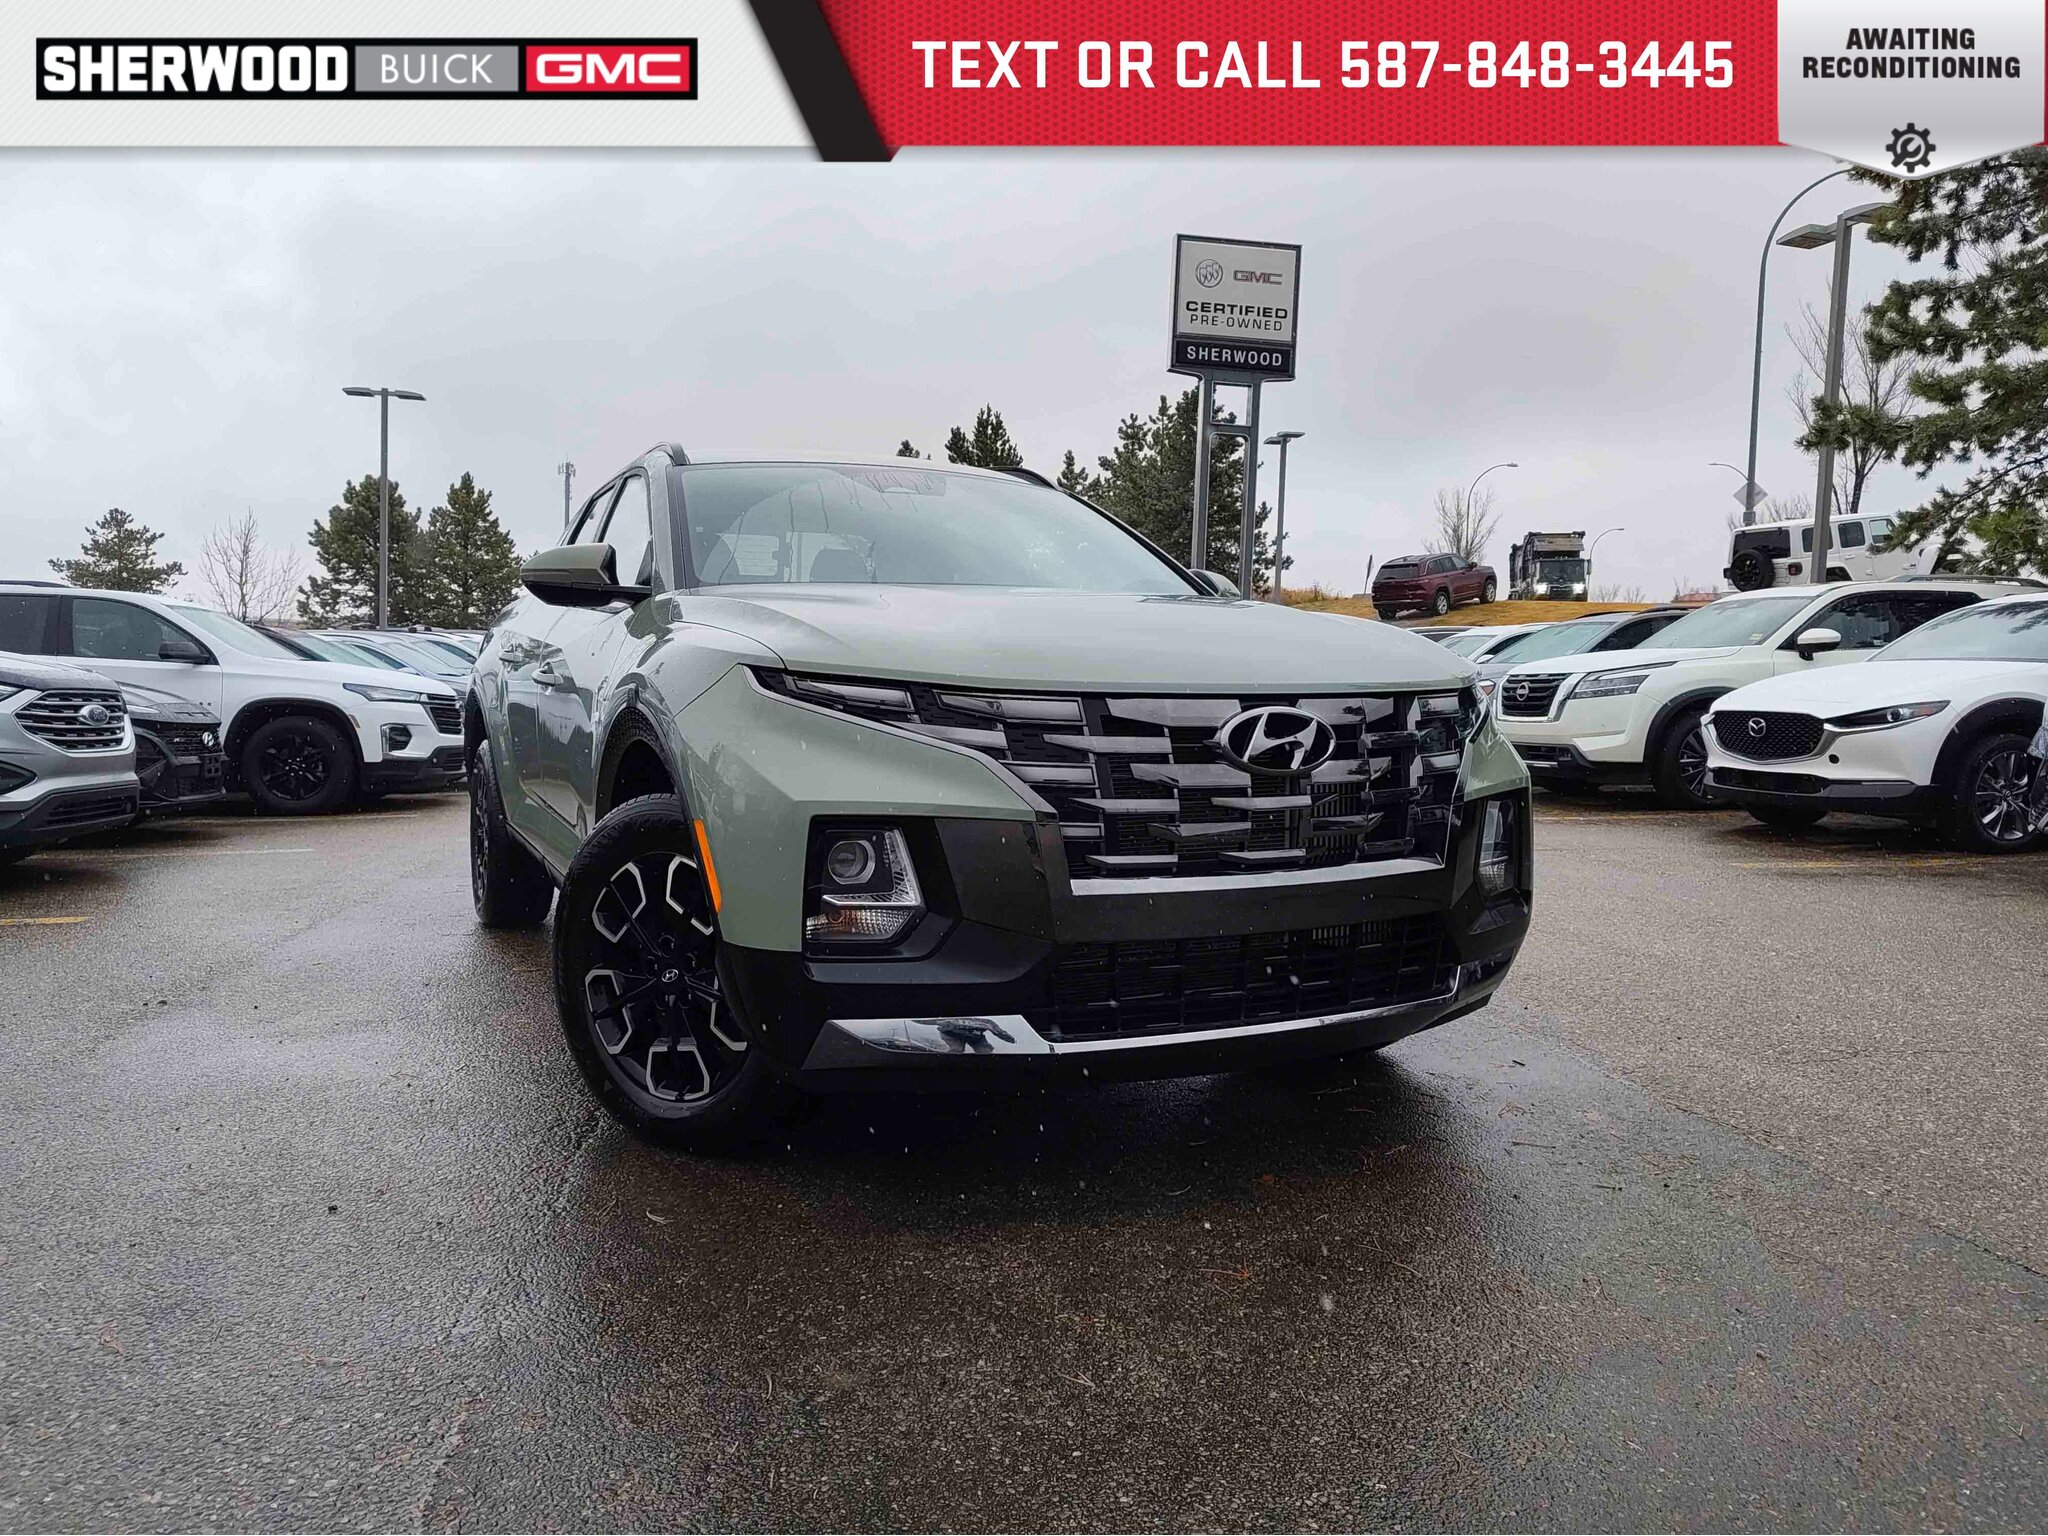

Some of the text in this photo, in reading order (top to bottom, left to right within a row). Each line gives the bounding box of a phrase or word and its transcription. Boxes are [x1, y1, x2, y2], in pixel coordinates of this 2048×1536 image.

[1233, 270, 1283, 285] GMC
[1185, 300, 1288, 319] CERTIFIED
[1190, 314, 1283, 331] PRE-OWNED
[1186, 345, 1283, 366] SHERWOOD
